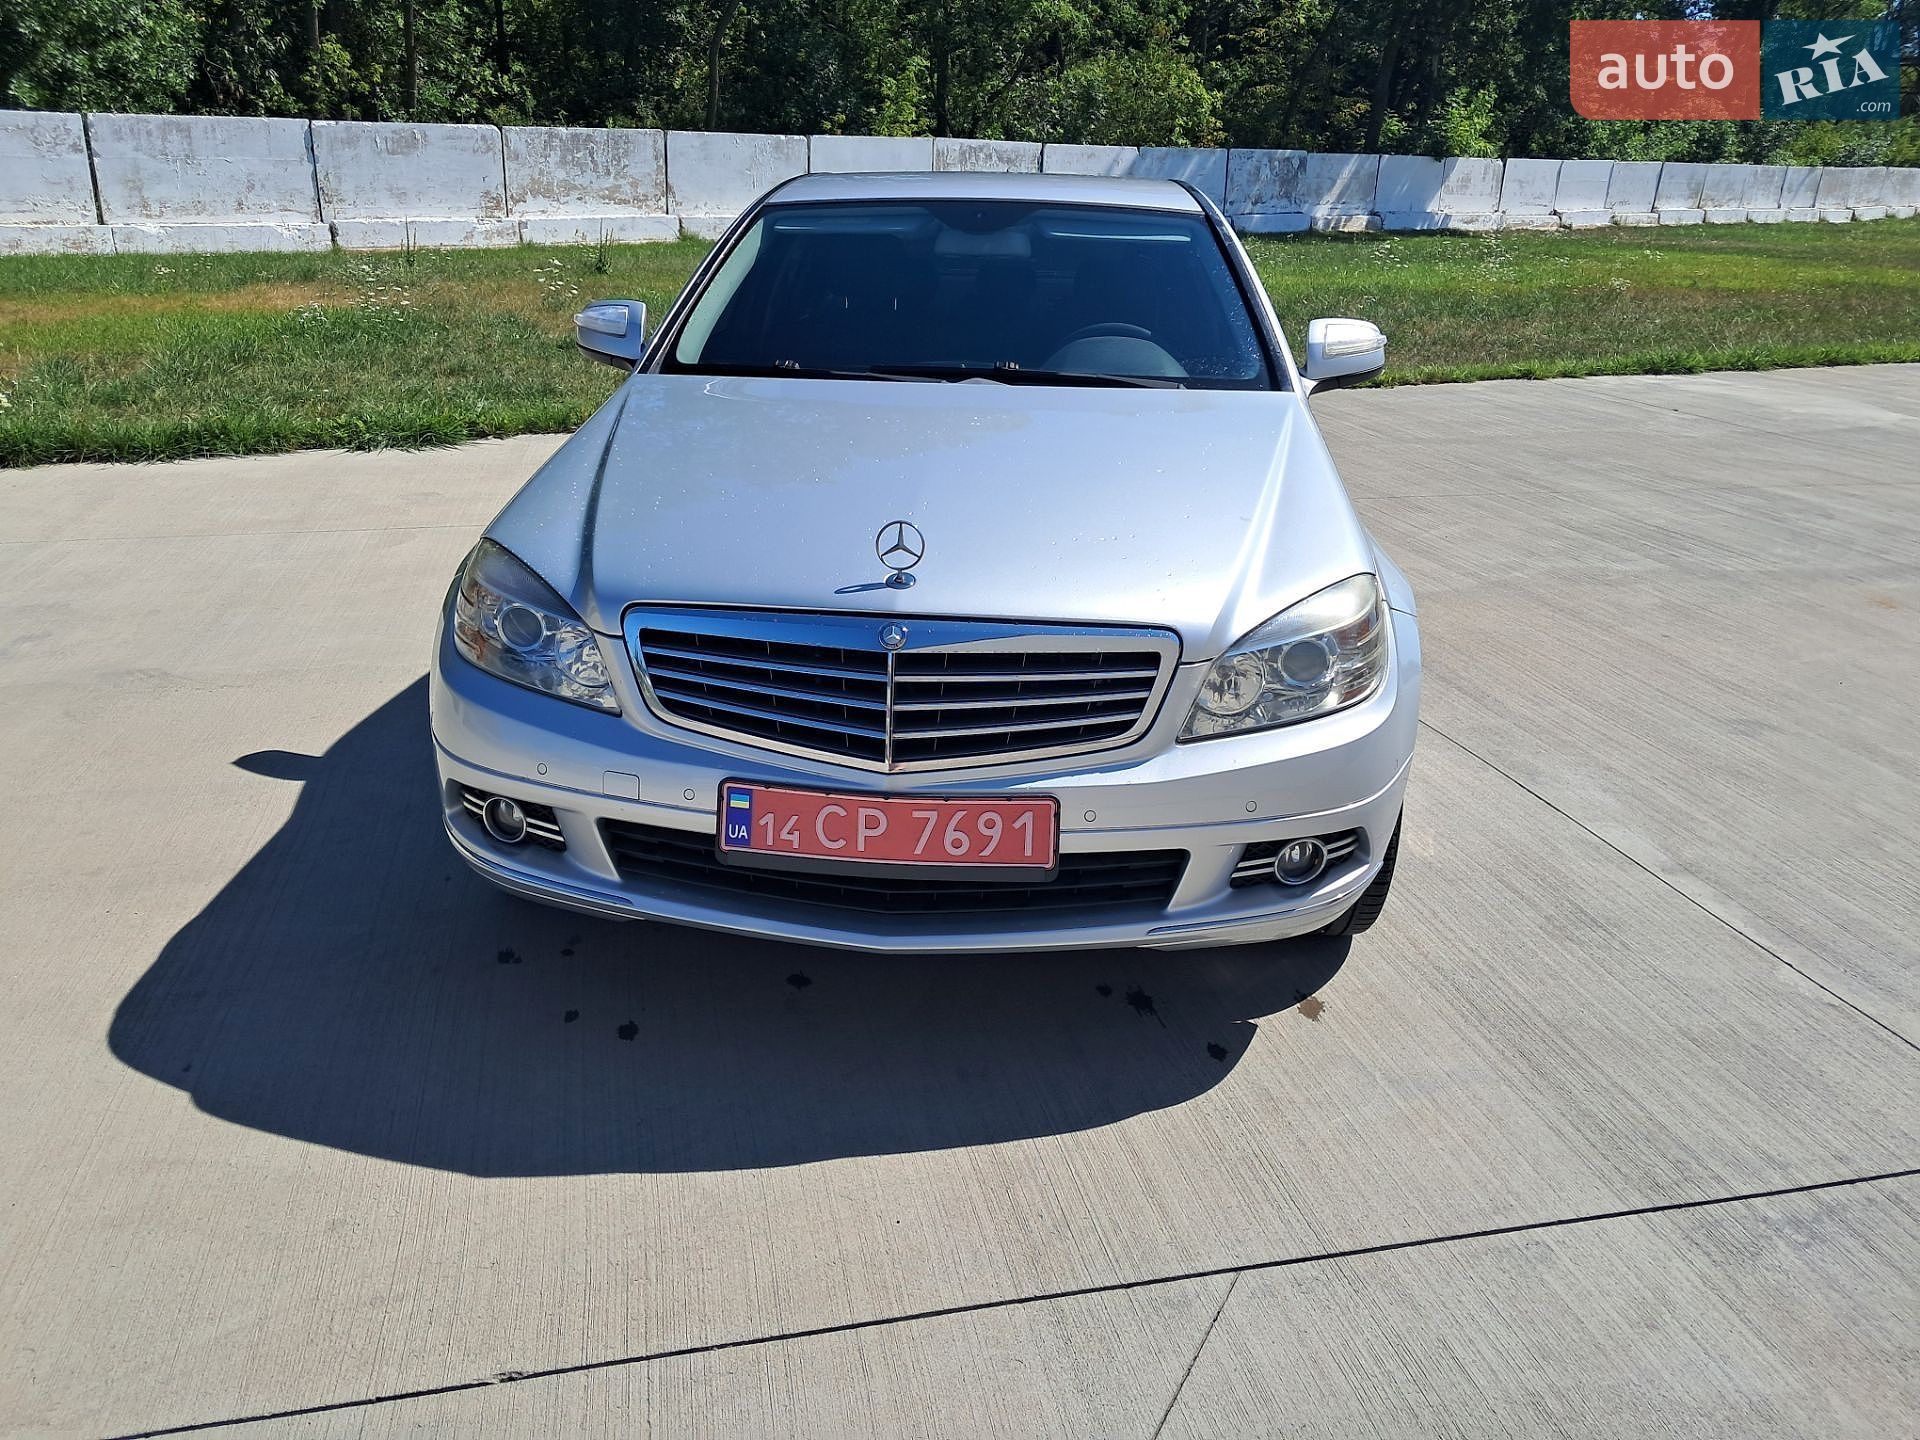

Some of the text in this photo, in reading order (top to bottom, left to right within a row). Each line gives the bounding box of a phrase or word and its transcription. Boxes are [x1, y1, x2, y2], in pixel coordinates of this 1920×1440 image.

[728, 824, 748, 840] UA
[758, 805, 1033, 857] 14 CP 7691
